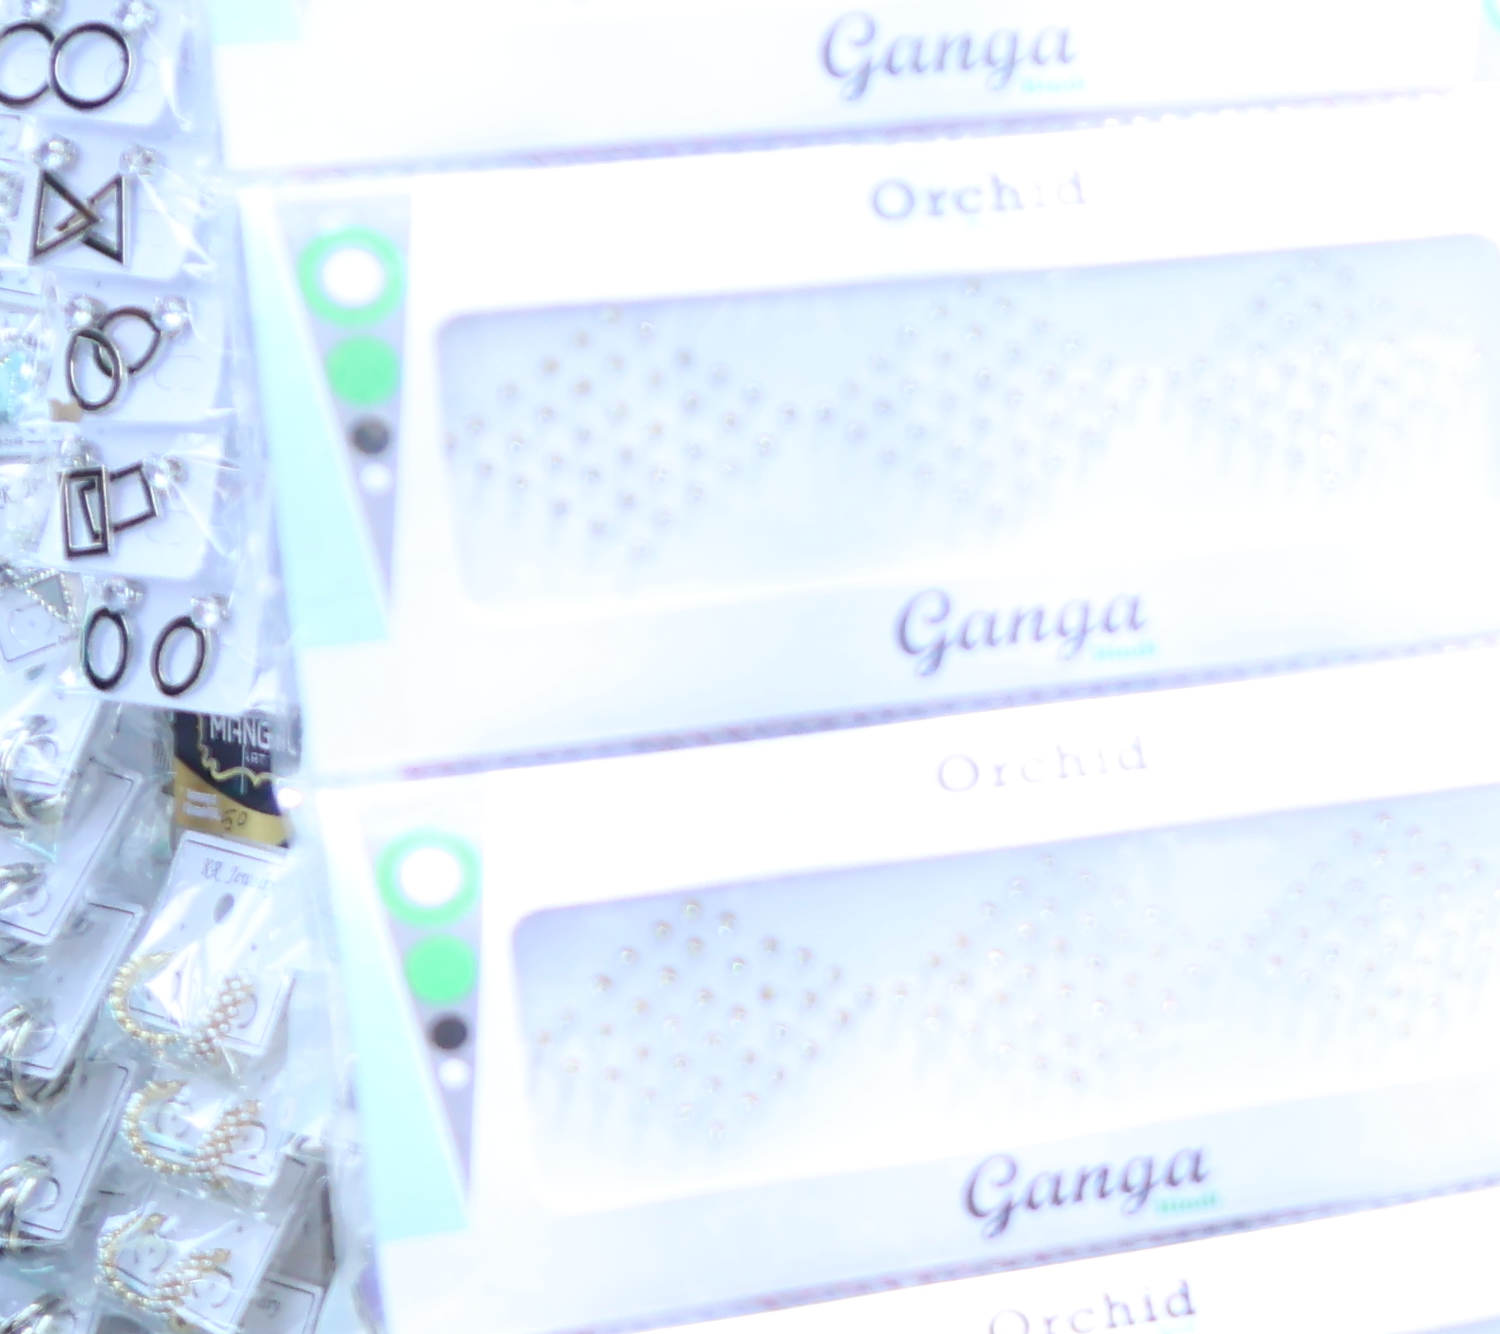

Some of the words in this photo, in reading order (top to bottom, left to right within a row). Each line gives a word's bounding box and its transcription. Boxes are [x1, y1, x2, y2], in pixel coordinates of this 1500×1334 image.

[818, 11, 1079, 104] Ganga
[869, 171, 1086, 224] Orchid
[895, 587, 1148, 679] Ganga
[936, 735, 1149, 793] Orchid
[963, 1143, 1212, 1239] Ganga
